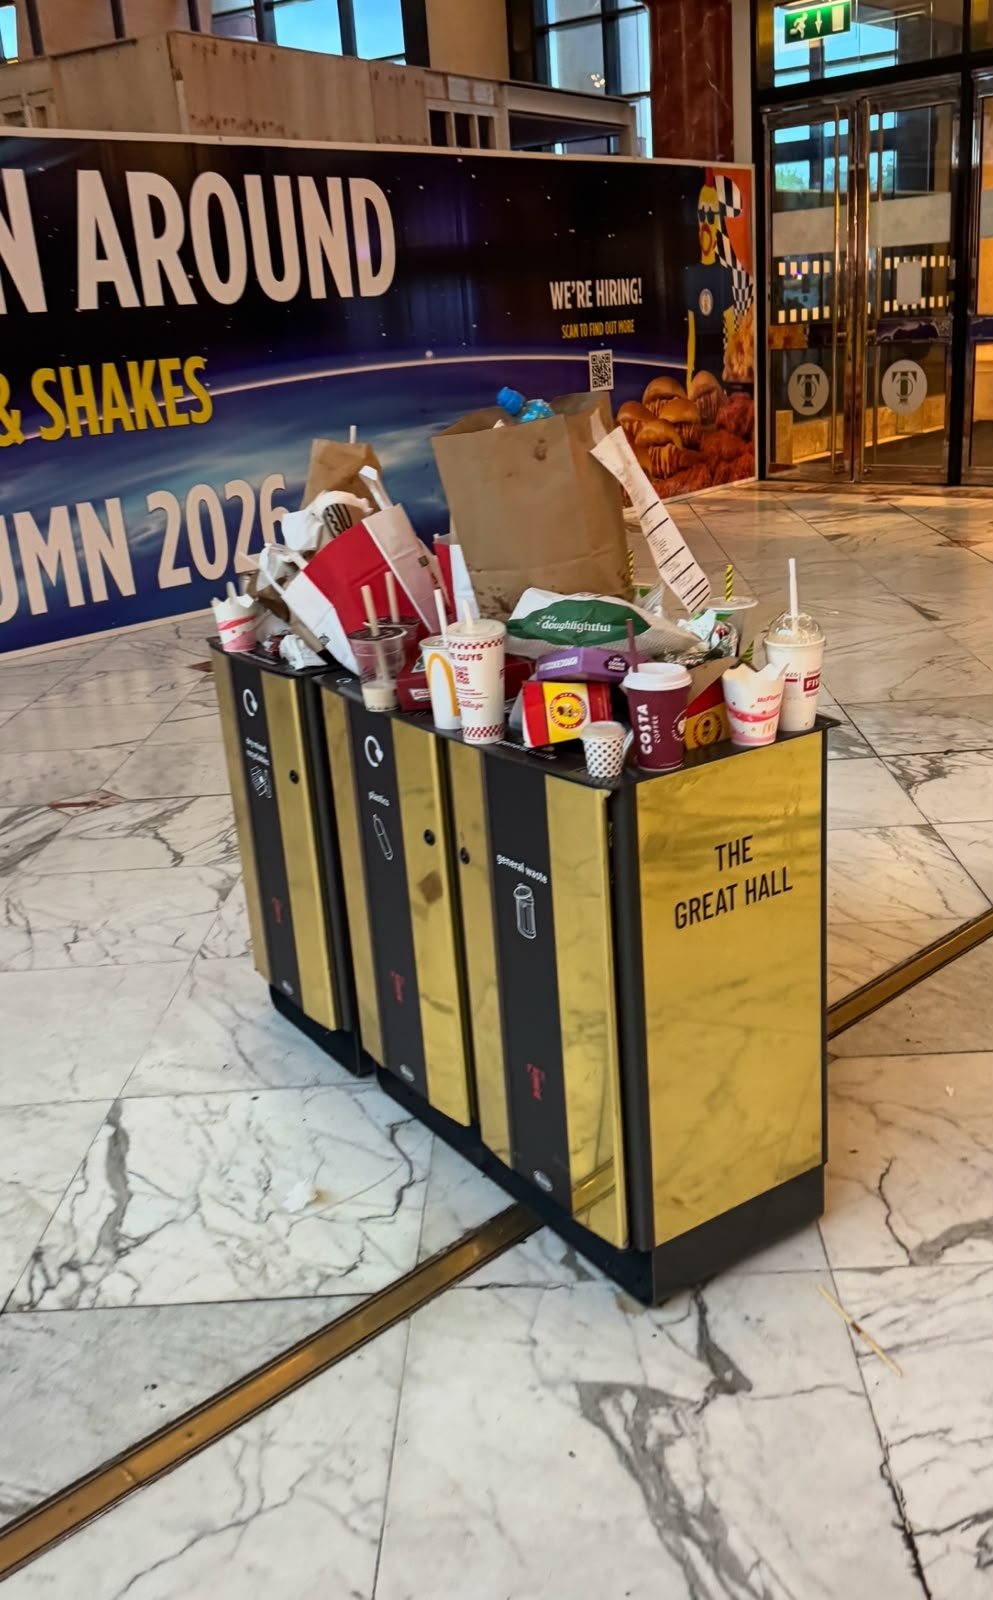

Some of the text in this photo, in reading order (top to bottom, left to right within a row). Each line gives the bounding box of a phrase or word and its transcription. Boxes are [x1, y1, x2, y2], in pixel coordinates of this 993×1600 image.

[77, 170, 396, 311] AROUND
[549, 277, 643, 310] WE'RE HIRING!
[561, 318, 635, 339] SCAN TO FIND OUT MORE
[31, 356, 213, 440] SHAKES
[146, 474, 287, 589] 2026
[637, 704, 653, 755] COSTA
[714, 835, 754, 872] THE
[674, 866, 794, 930] GREAT HALL
